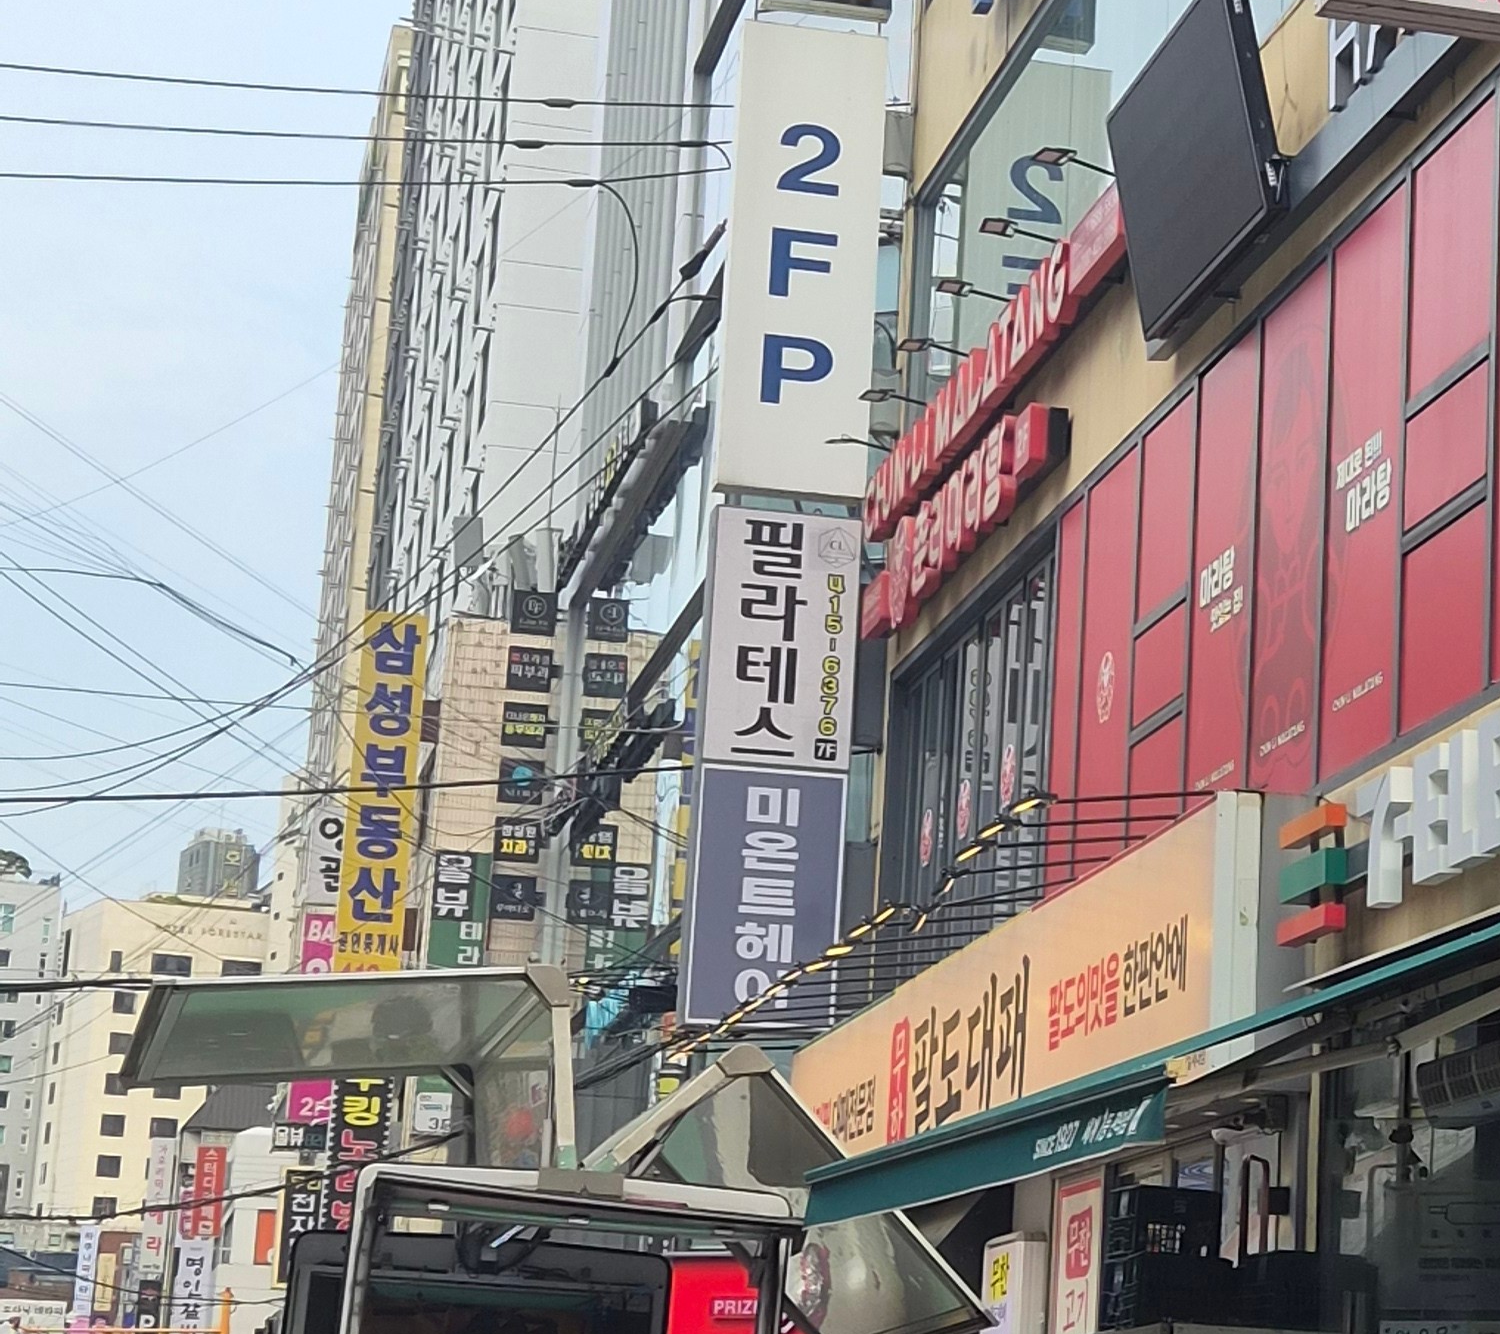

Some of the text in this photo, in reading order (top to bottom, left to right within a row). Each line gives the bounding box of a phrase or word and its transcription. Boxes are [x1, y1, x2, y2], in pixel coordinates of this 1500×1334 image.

[933, 238, 1071, 463] MALATANG
[1344, 456, 1393, 534] 마라탕
[730, 518, 809, 759] 필라테스
[1199, 544, 1236, 610] 마라탕
[347, 621, 421, 924] 삼성부동산
[816, 740, 840, 761] 7F
[911, 954, 1031, 1135] 팔도대패
[1046, 951, 1121, 1053] 팔도의맛을
[1122, 913, 1189, 1018] 한판안에
[712, 1299, 758, 1316] PRIZ
